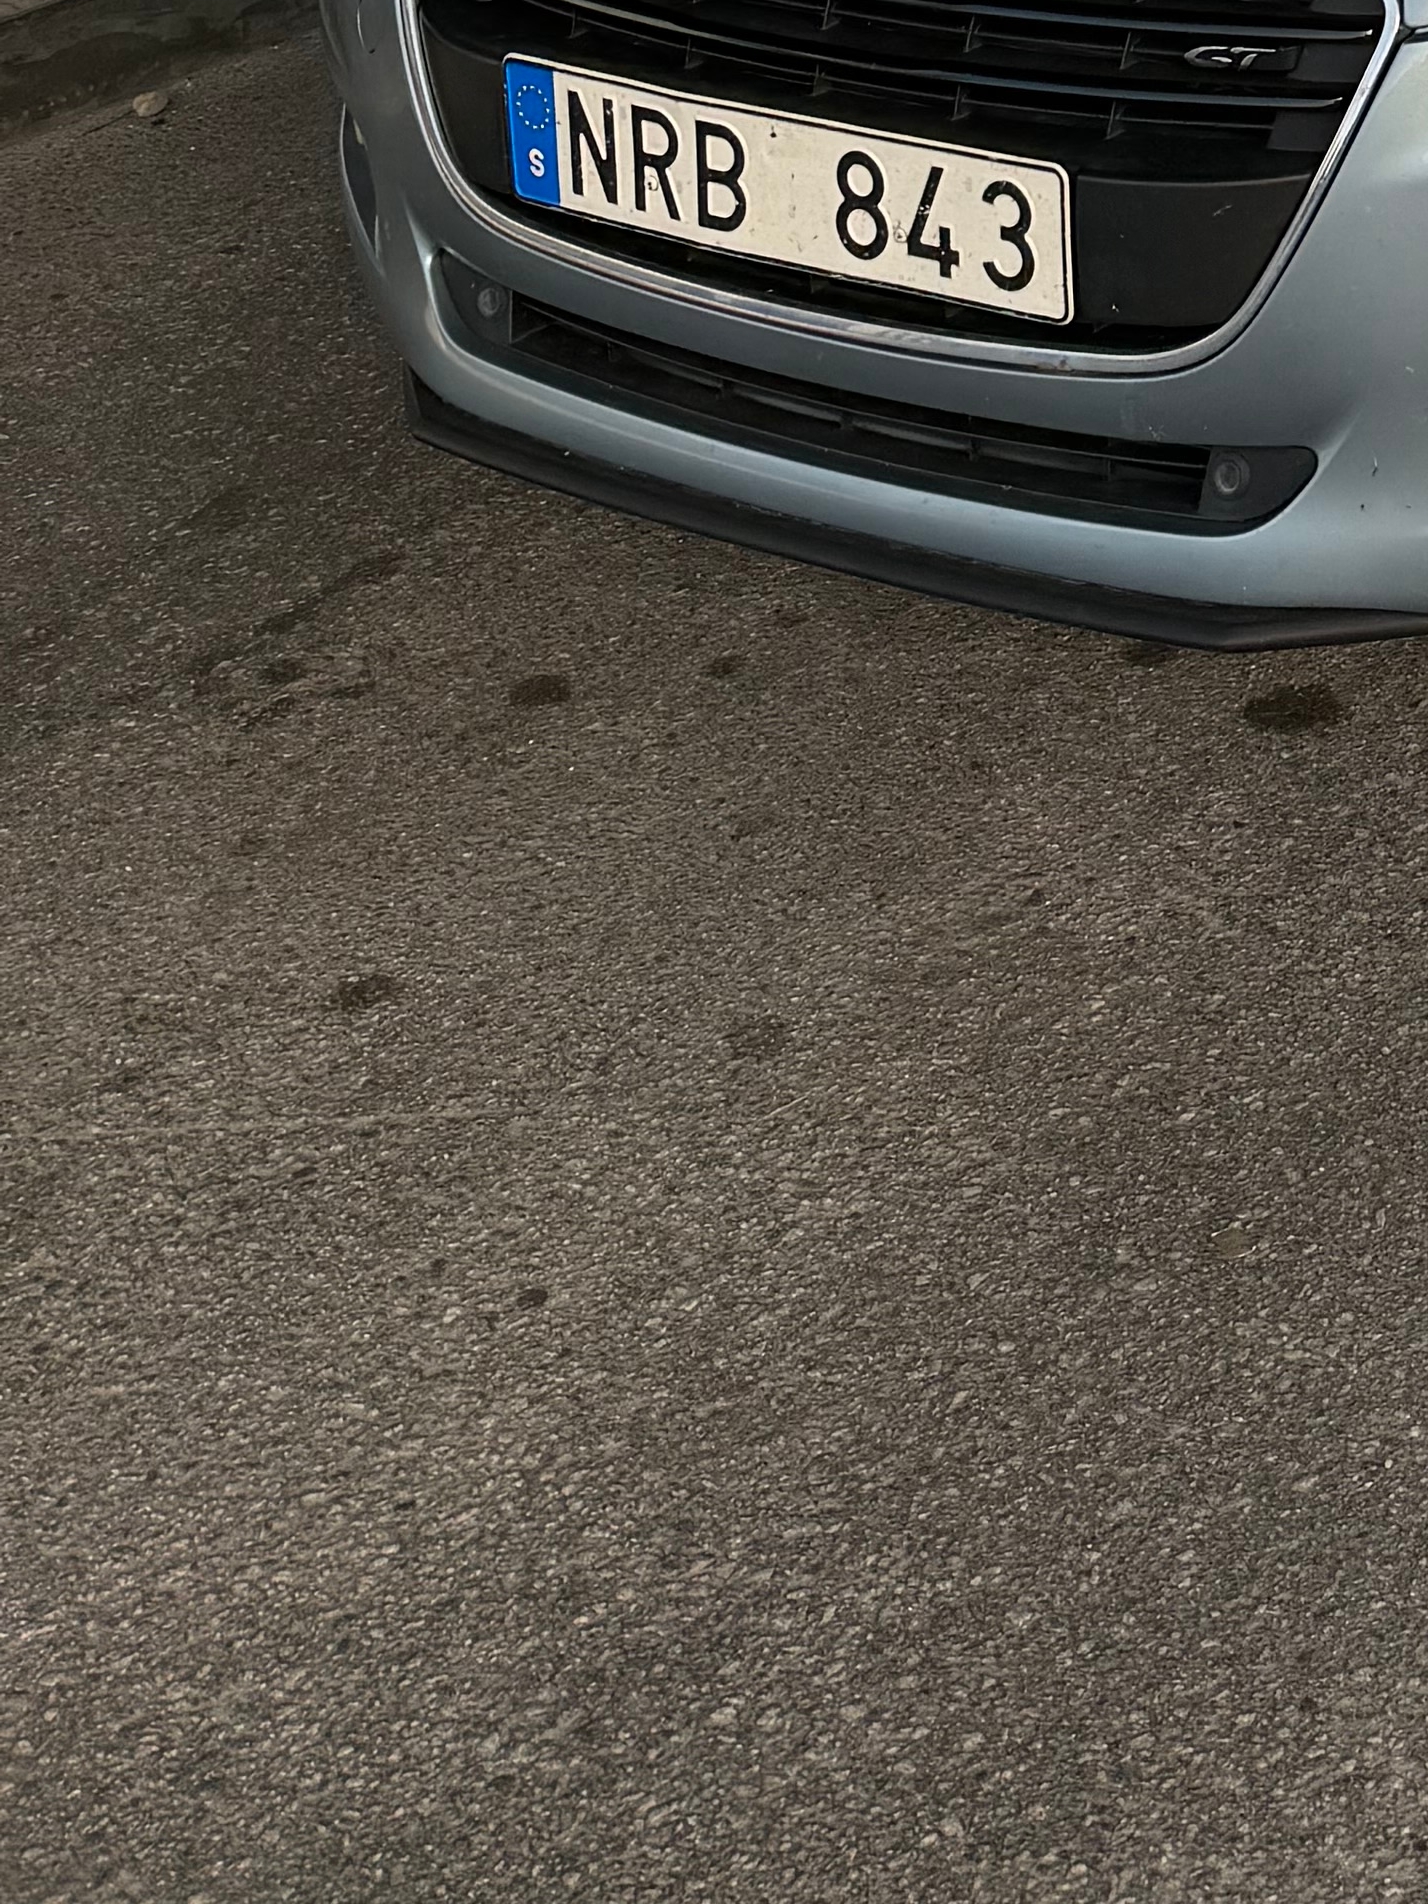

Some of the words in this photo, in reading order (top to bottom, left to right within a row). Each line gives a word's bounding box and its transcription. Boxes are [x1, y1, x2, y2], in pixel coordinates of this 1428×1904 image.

[1182, 44, 1279, 73] GT
[528, 147, 545, 178] S
[567, 88, 747, 233] NRB
[834, 149, 1038, 292] 843
